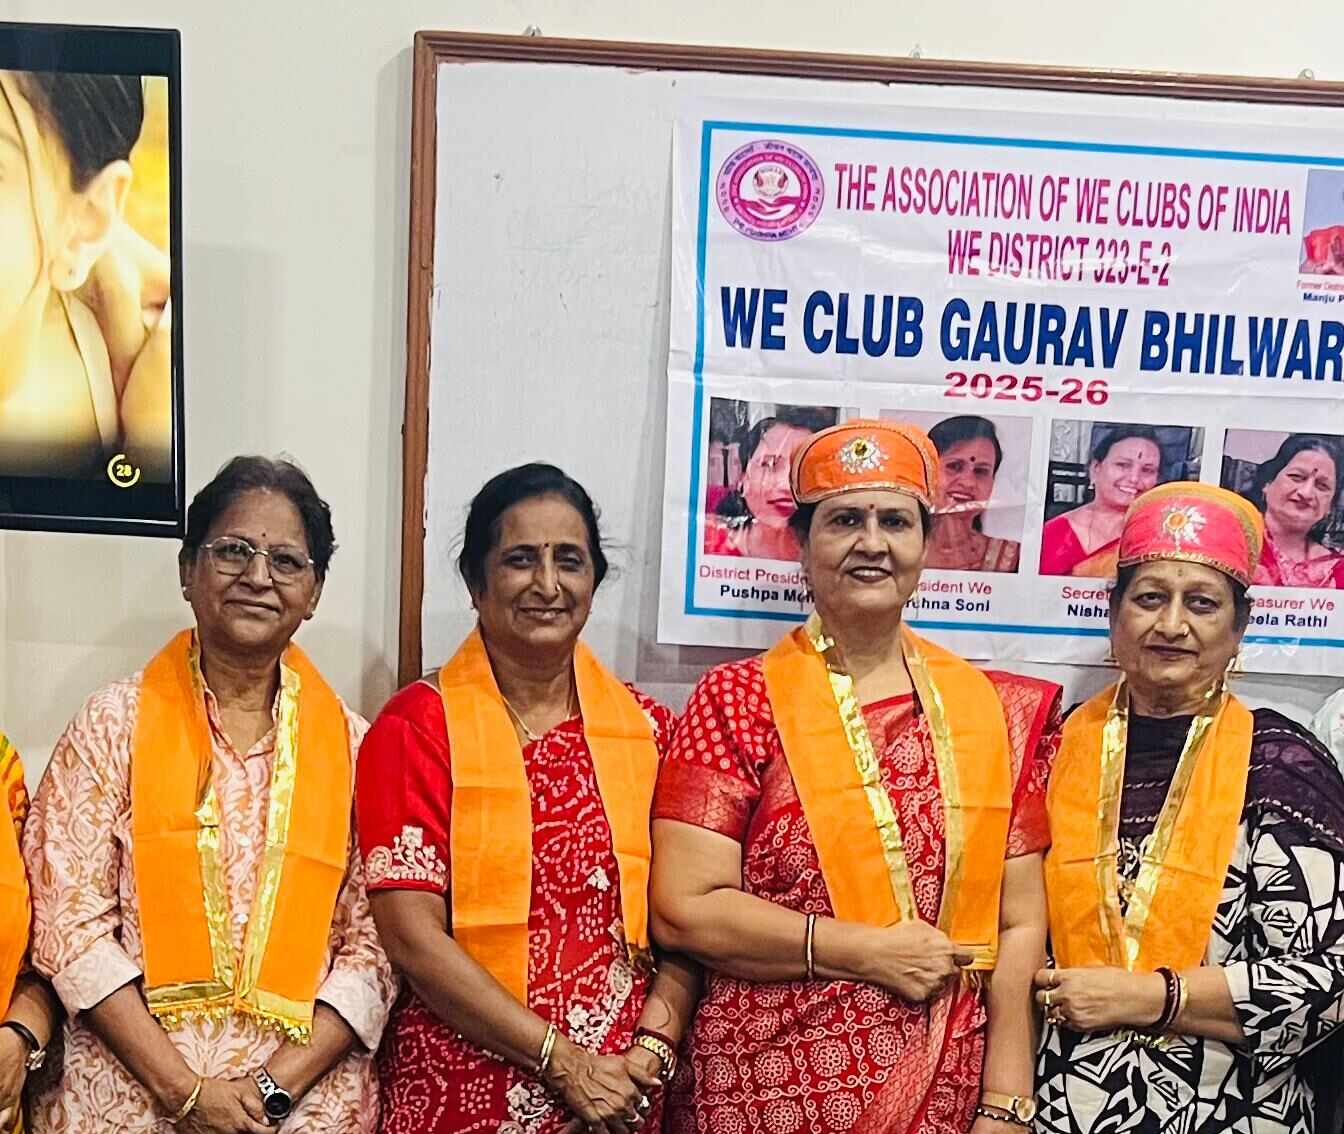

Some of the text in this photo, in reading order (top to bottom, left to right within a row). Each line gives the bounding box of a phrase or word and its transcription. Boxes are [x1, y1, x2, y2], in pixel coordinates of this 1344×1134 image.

[835, 163, 877, 212] THE
[881, 166, 1033, 220] ASSOCIATION
[1039, 175, 1070, 222] OF
[1076, 177, 1111, 225] WE
[1116, 179, 1191, 229] CLUBS
[1197, 184, 1229, 231] OF
[1232, 186, 1291, 235] INDIA
[948, 229, 1172, 287] WE DISTRICT 323-E-2
[1303, 292, 1335, 304] Manju
[720, 286, 788, 350] WE
[803, 289, 924, 357] CLUB
[939, 297, 1128, 369] GAURAV
[943, 372, 1110, 405] 2025-26
[699, 565, 750, 580] District
[720, 585, 779, 602] Pushpa
[968, 581, 992, 595] We
[956, 598, 990, 612] Soni
[1311, 598, 1335, 611] We
[1285, 614, 1328, 628] Rathi
